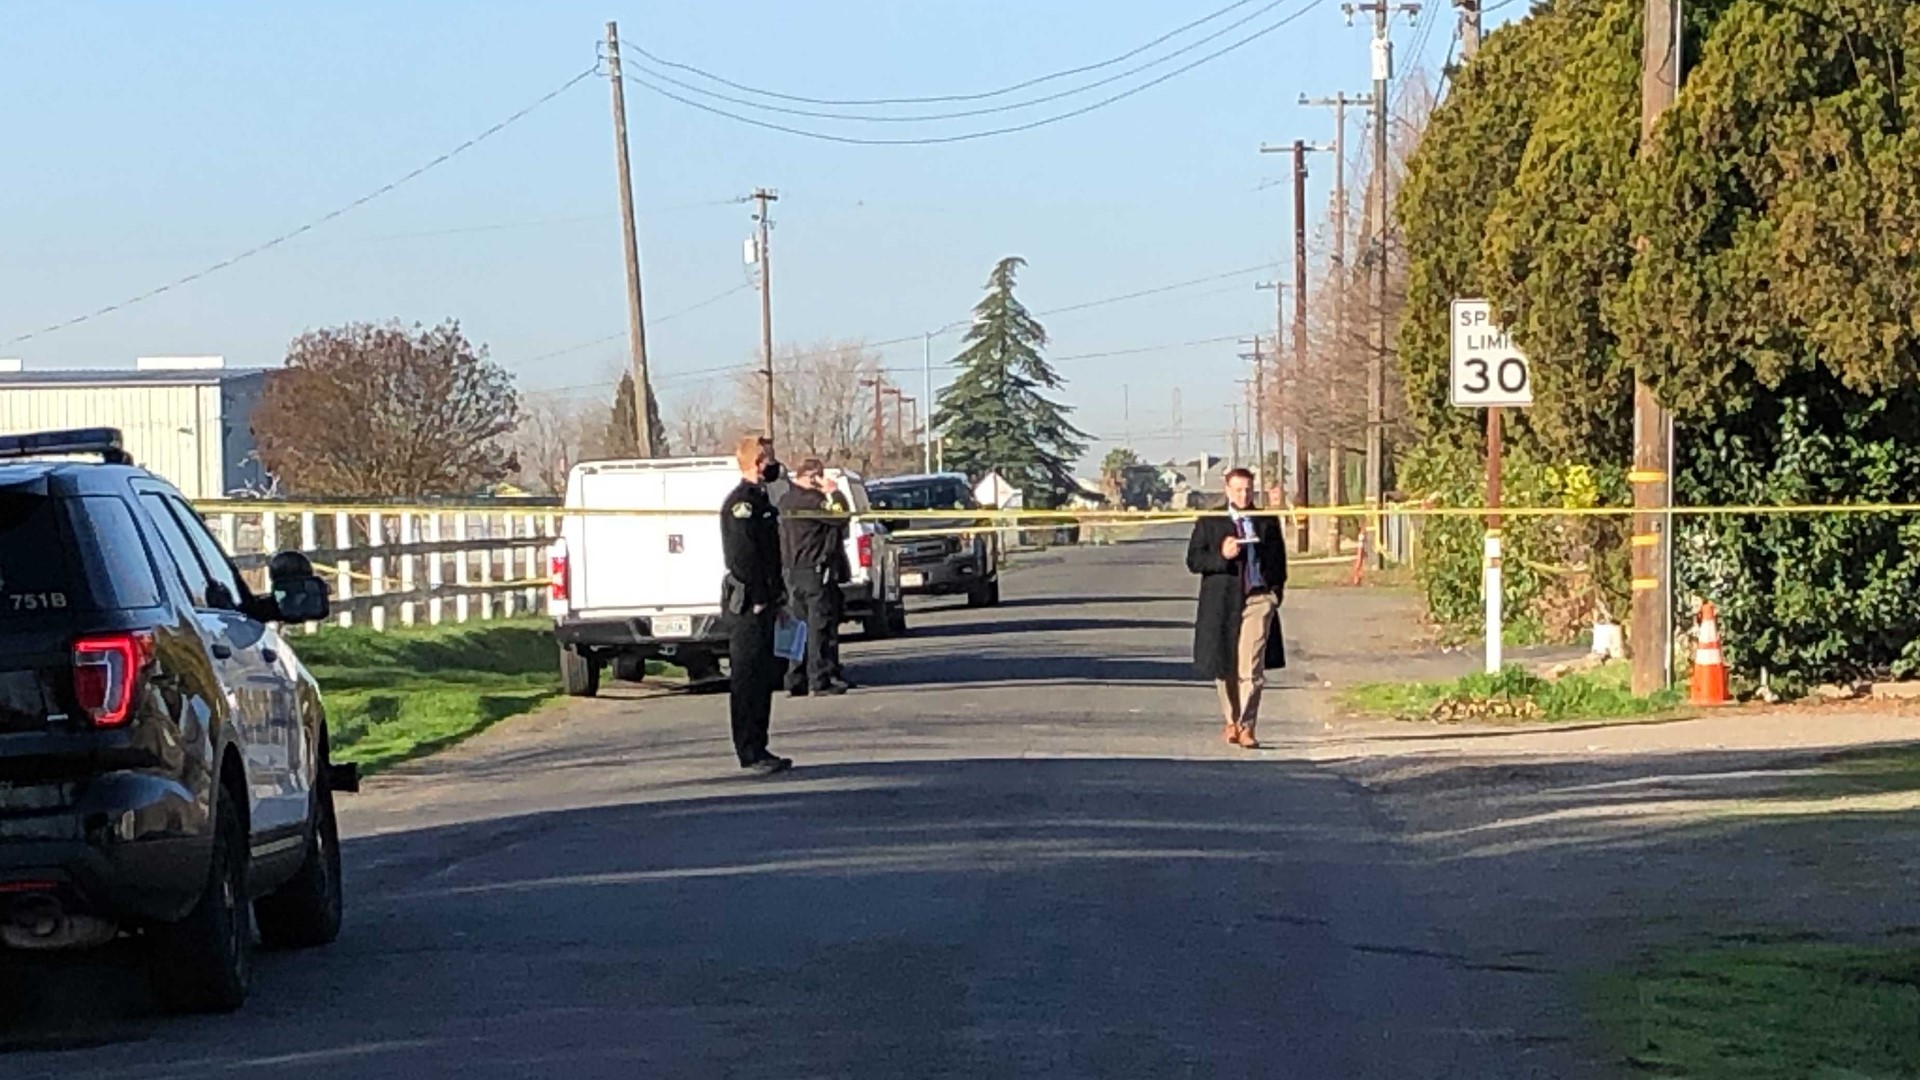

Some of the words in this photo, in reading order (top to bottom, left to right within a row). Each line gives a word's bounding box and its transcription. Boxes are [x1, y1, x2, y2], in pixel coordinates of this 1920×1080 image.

[1467, 334, 1508, 350] LIMI
[1462, 357, 1527, 394] 30
[9, 592, 67, 610] 751B
